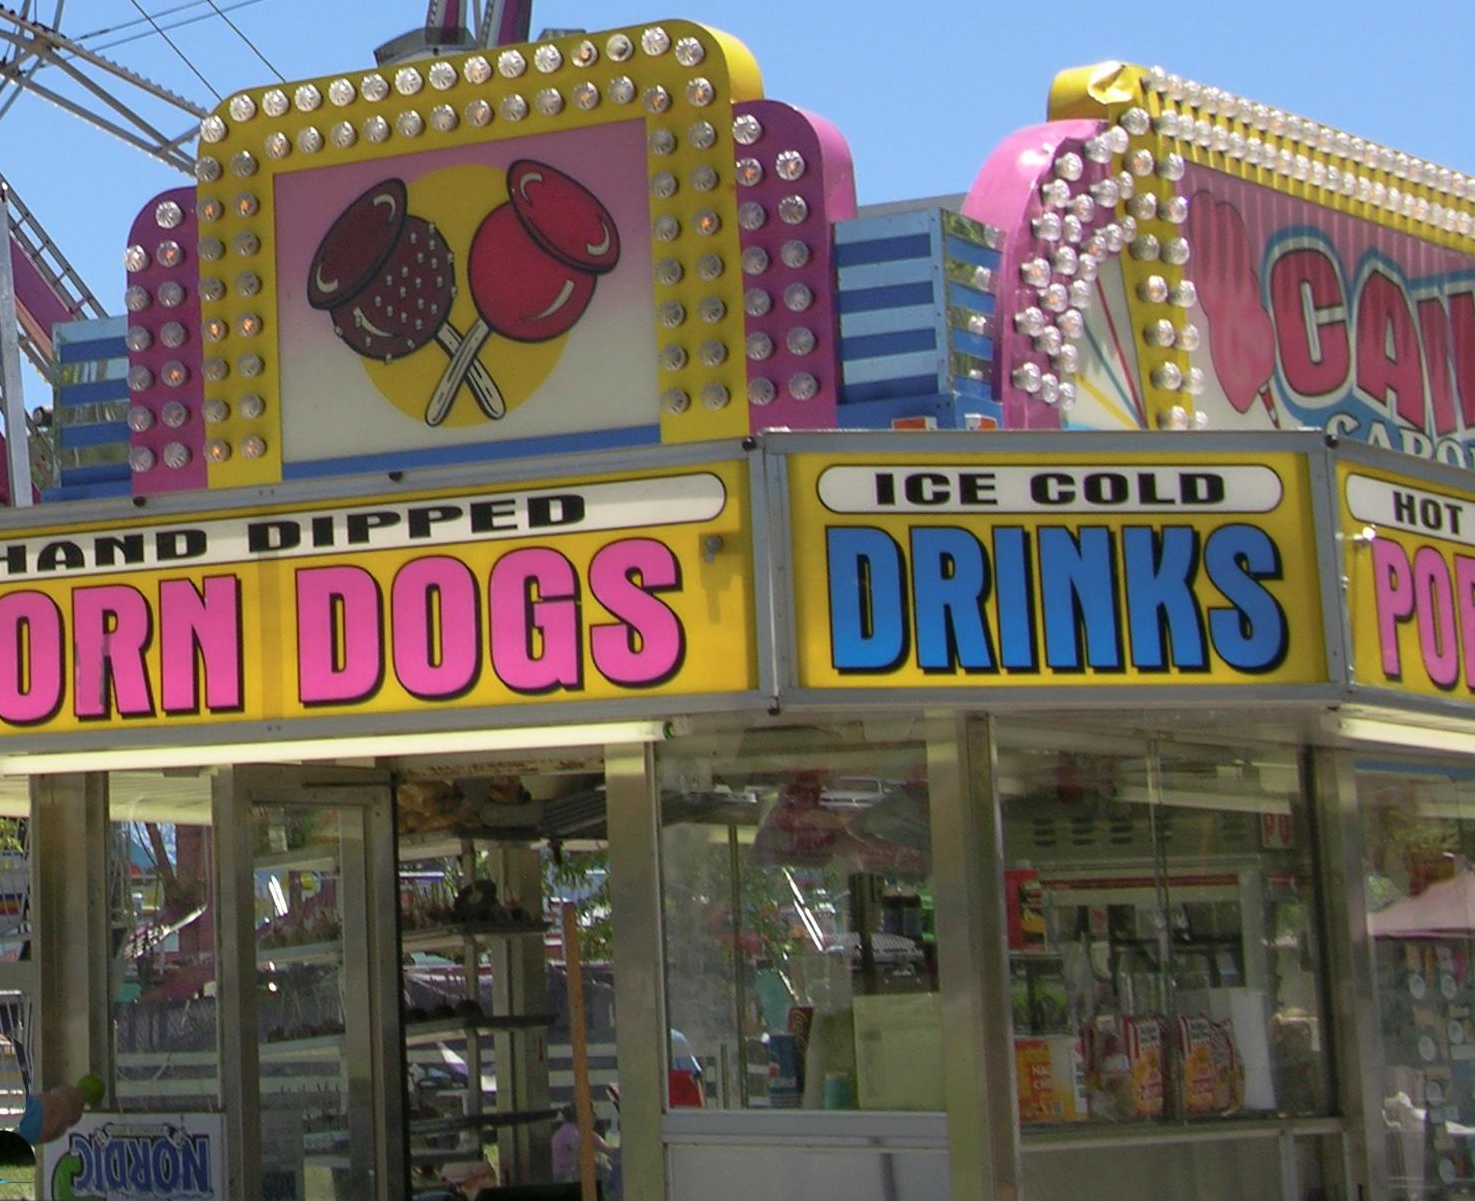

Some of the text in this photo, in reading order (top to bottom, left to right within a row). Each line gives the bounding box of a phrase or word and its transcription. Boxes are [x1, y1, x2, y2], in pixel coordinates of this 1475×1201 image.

[876, 472, 1225, 506] ICE COLD
[1392, 491, 1463, 536] HOT
[248, 493, 586, 554] DIPPED
[295, 538, 686, 707] DOGS
[825, 522, 1290, 676] DRINKS
[71, 1134, 211, 1195] NORDIC
